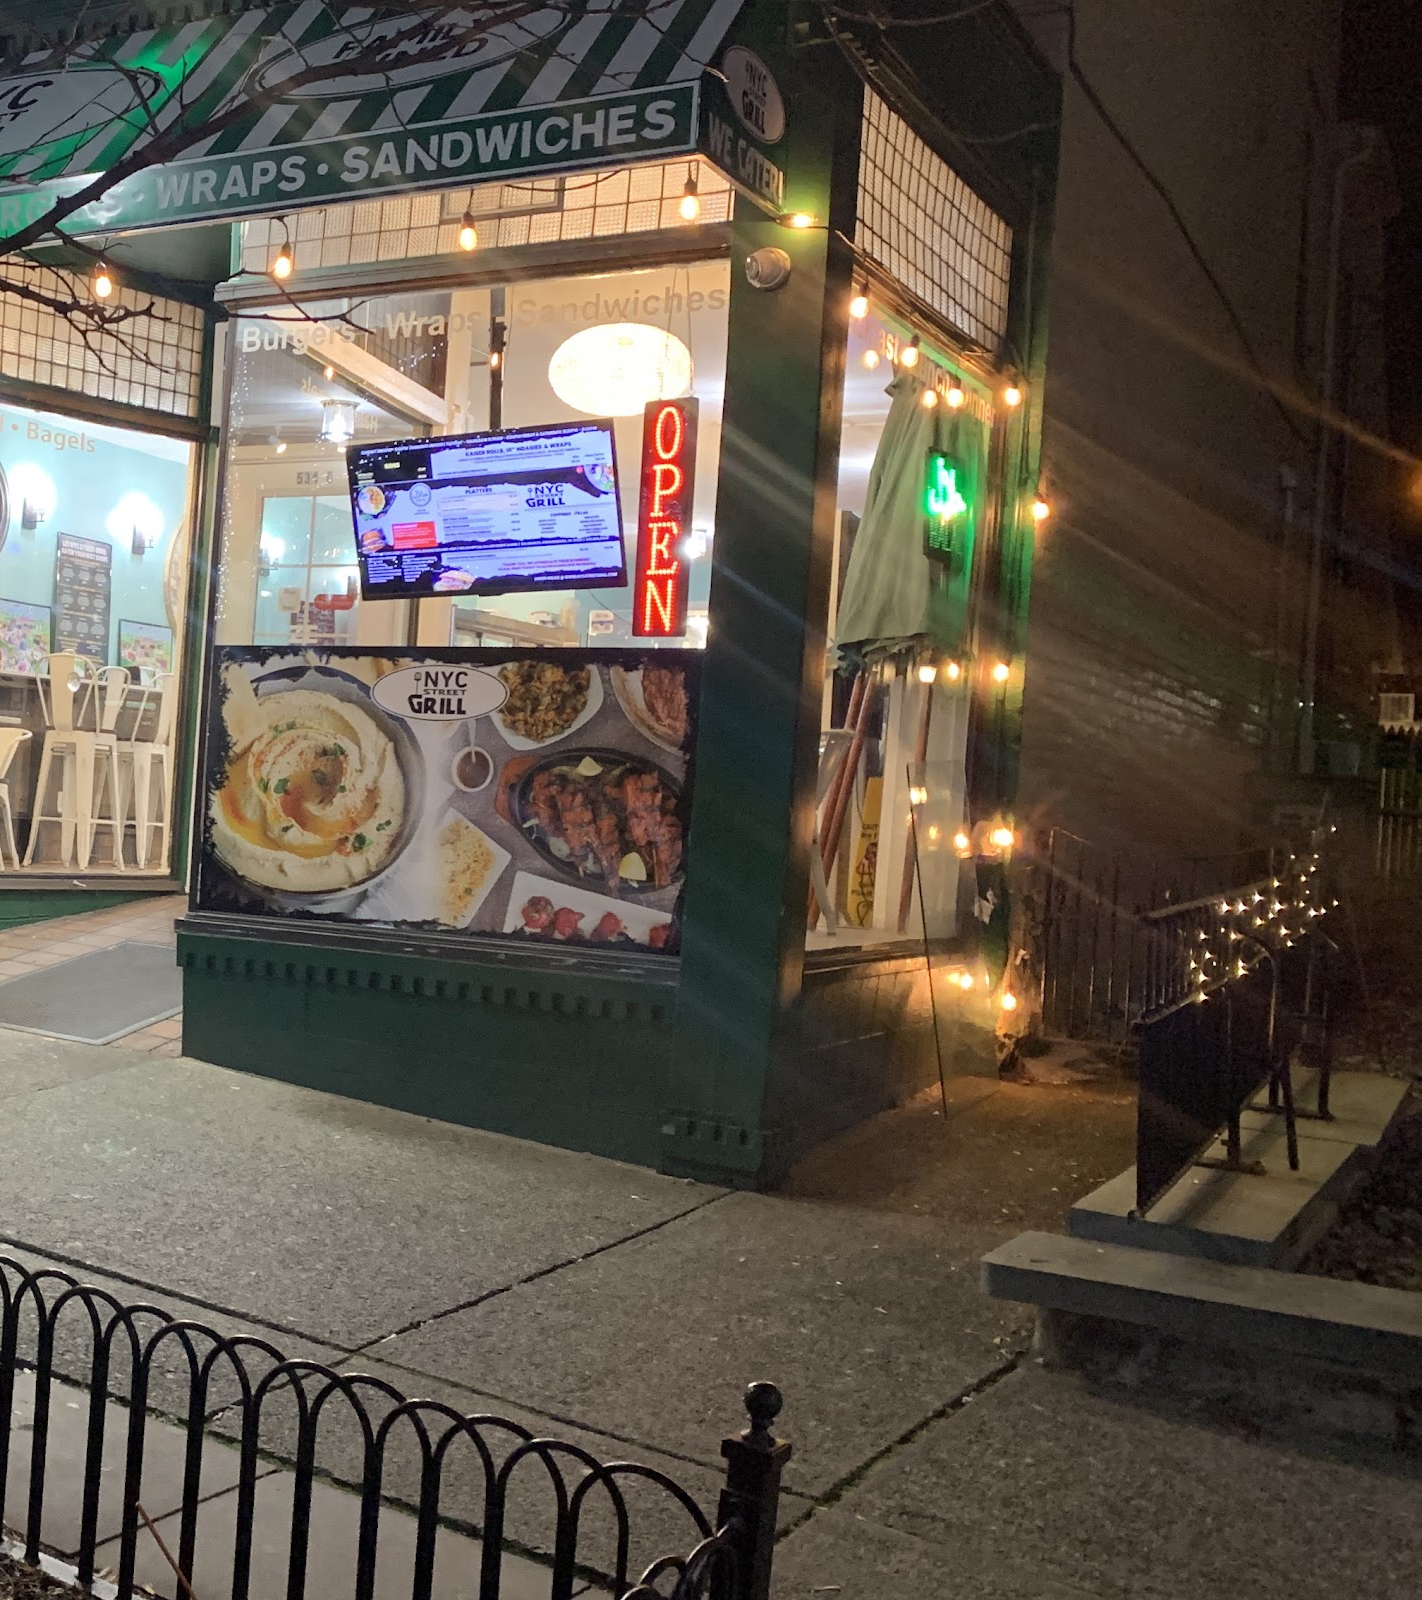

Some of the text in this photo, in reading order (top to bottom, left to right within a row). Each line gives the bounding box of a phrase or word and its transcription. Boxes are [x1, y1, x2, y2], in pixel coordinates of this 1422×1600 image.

[709, 111, 734, 168] WE
[154, 155, 306, 210] WRAPS
[340, 99, 676, 183] SANDWICHES
[242, 286, 726, 355] Burgers Wraps Sandwiches
[27, 421, 96, 452] Bagels
[526, 497, 566, 508] GRILL
[534, 485, 564, 494] NYC
[644, 405, 683, 633] OPEN
[423, 688, 467, 696] STREET
[424, 671, 468, 688] NYC
[408, 694, 466, 715] GRILL
